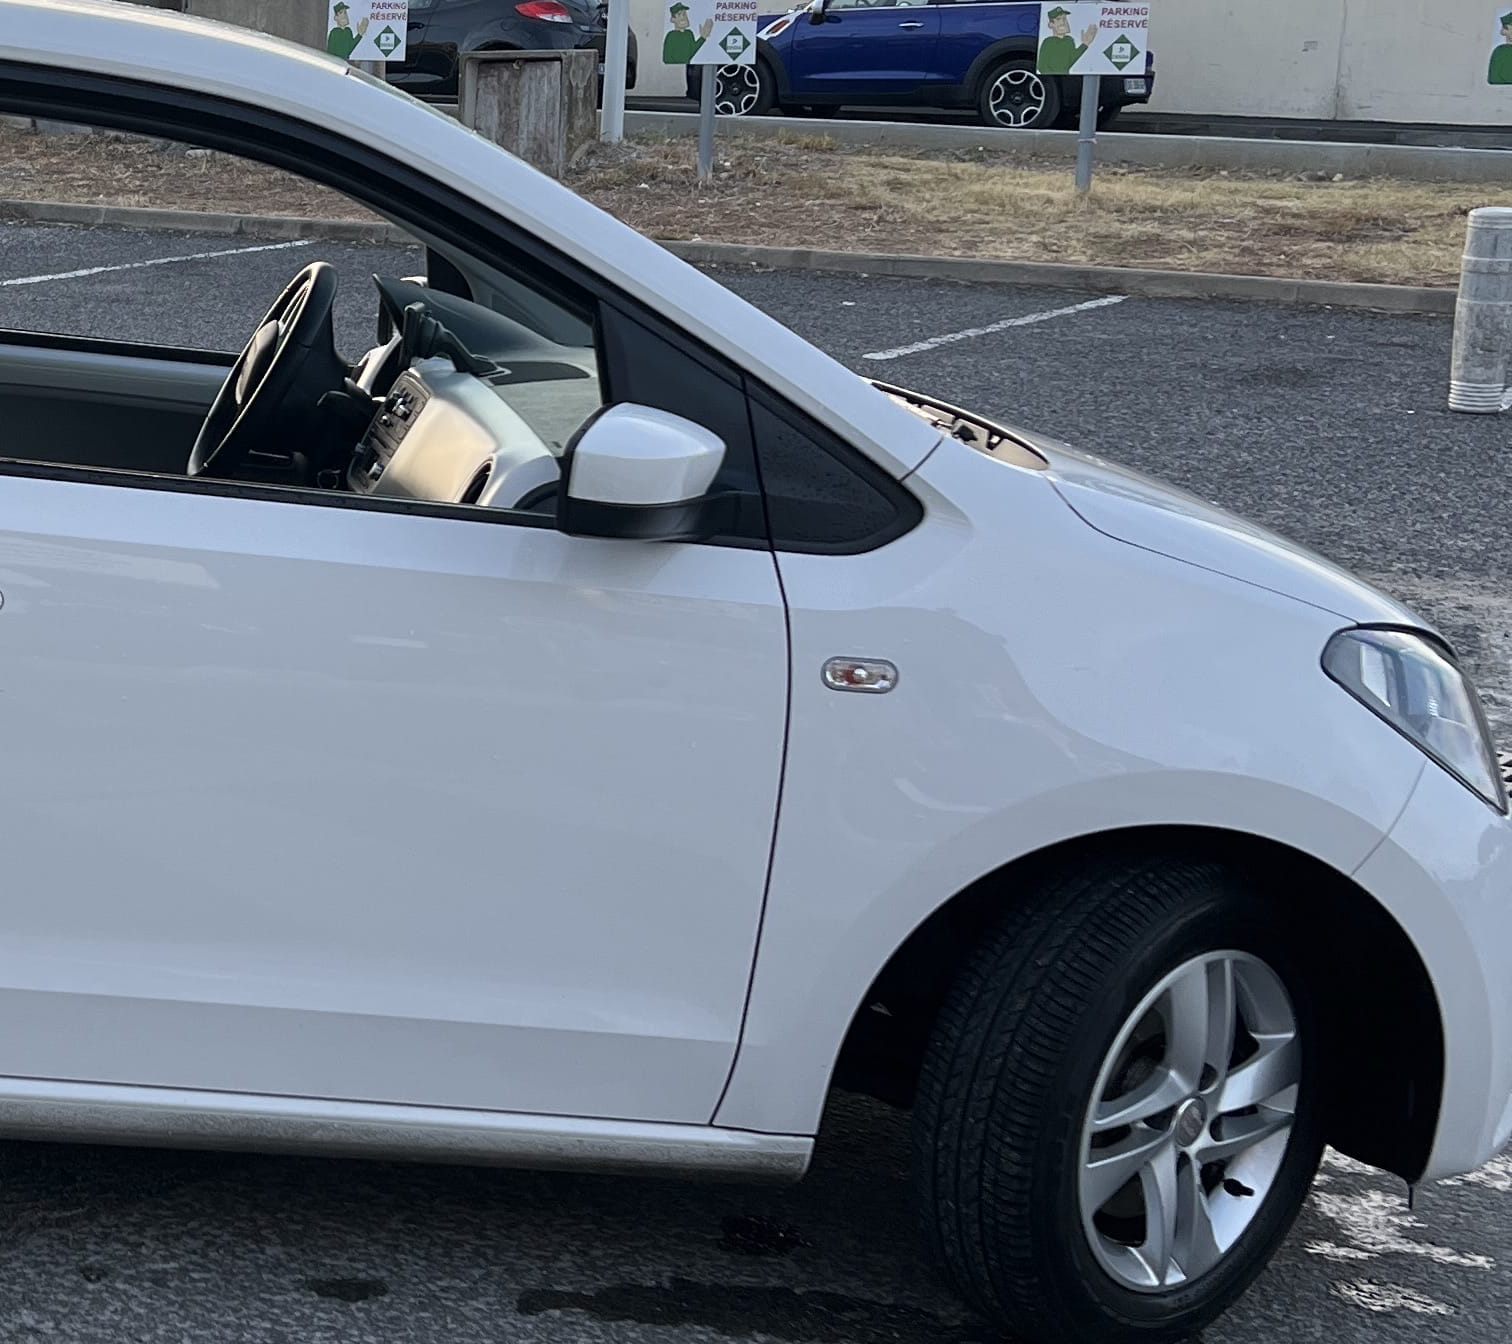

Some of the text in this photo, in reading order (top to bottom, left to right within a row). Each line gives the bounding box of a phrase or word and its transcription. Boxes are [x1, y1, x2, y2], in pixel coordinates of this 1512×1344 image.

[371, 2, 407, 10] PARKING
[716, 1, 757, 10] PARKING
[1101, 6, 1148, 16] PARKING
